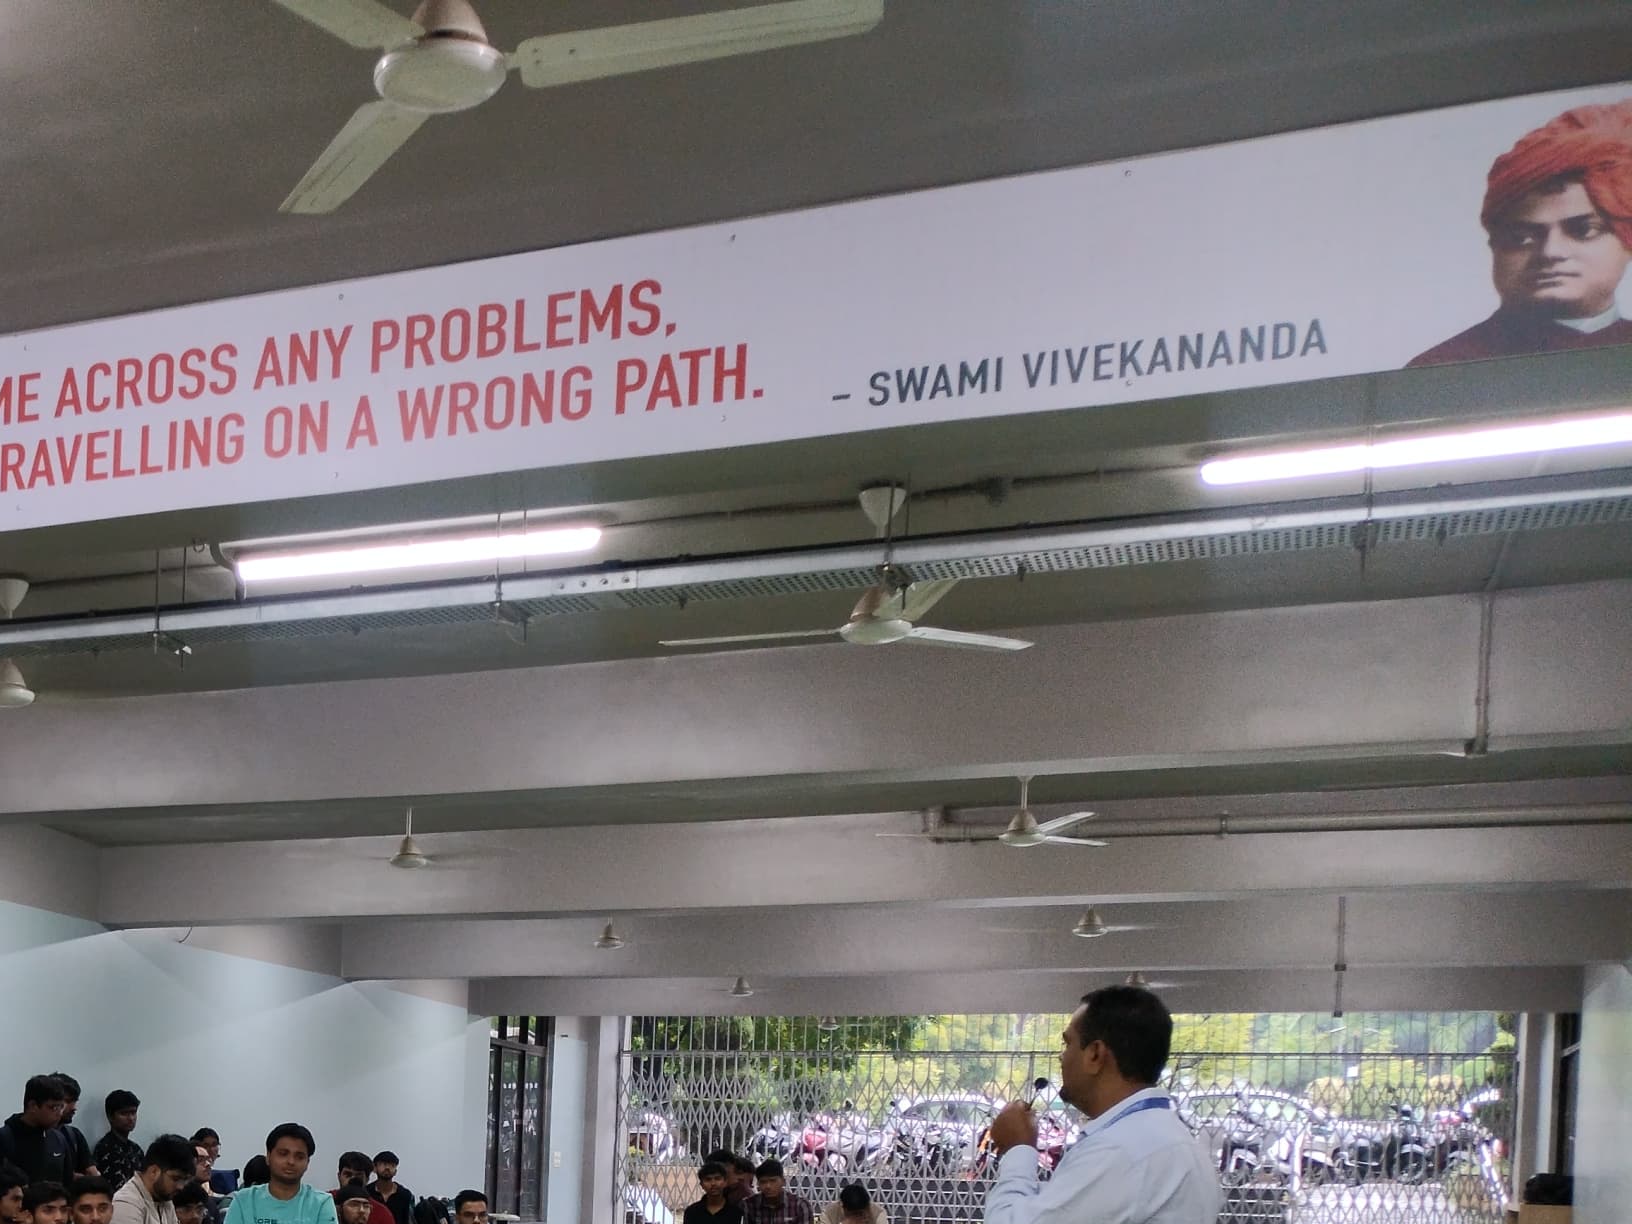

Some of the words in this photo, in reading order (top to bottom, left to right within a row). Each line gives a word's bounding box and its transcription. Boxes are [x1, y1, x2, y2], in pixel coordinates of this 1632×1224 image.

[54, 342, 239, 418] ACROSS
[253, 324, 353, 390] ANY
[370, 278, 677, 374] PROBLEMS,
[264, 400, 330, 459] ON
[346, 395, 378, 449] A
[398, 364, 593, 442] WRONG
[614, 343, 764, 416] PATH.
[868, 356, 1003, 407] SWAMI
[1022, 317, 1329, 389] VIVEKANANDA
